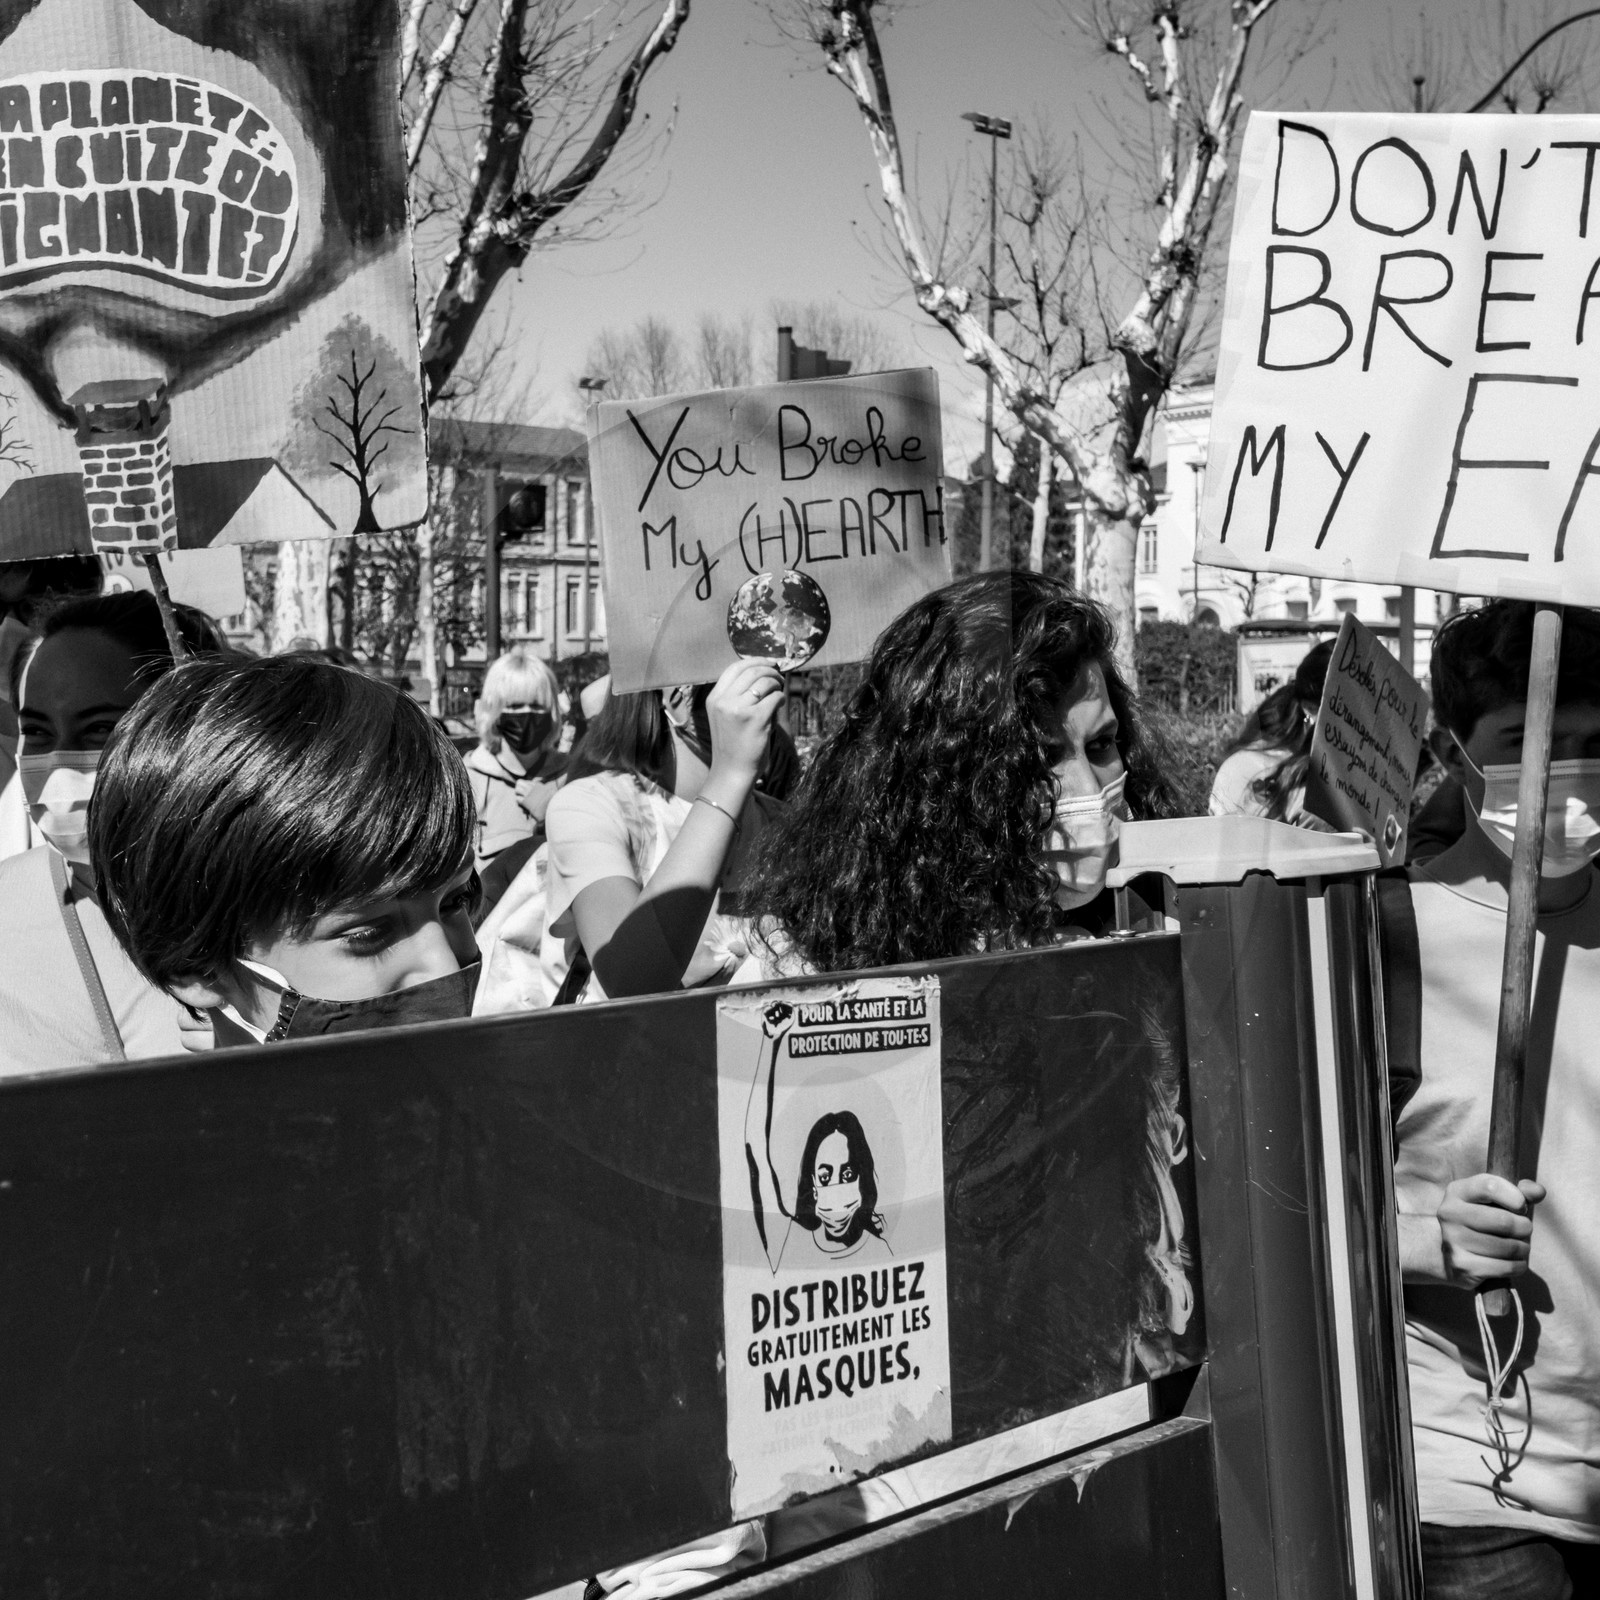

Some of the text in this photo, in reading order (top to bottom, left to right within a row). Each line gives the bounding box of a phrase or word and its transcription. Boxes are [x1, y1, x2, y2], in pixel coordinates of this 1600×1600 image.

[1272, 119, 1600, 240] DON'T
[626, 404, 927, 513] You Broke
[1220, 424, 1371, 552] MY
[641, 486, 948, 602] My (H)EARTH
[791, 1032, 861, 1055] PROTECTION
[864, 1031, 880, 1049] DE
[801, 997, 924, 1023] POUR LA SANTÉ ET LA
[751, 1261, 925, 1334] DISTRIBUEZ
[747, 1305, 931, 1367] GRATUITEMENT LES
[763, 1341, 920, 1412] MASQUES,
